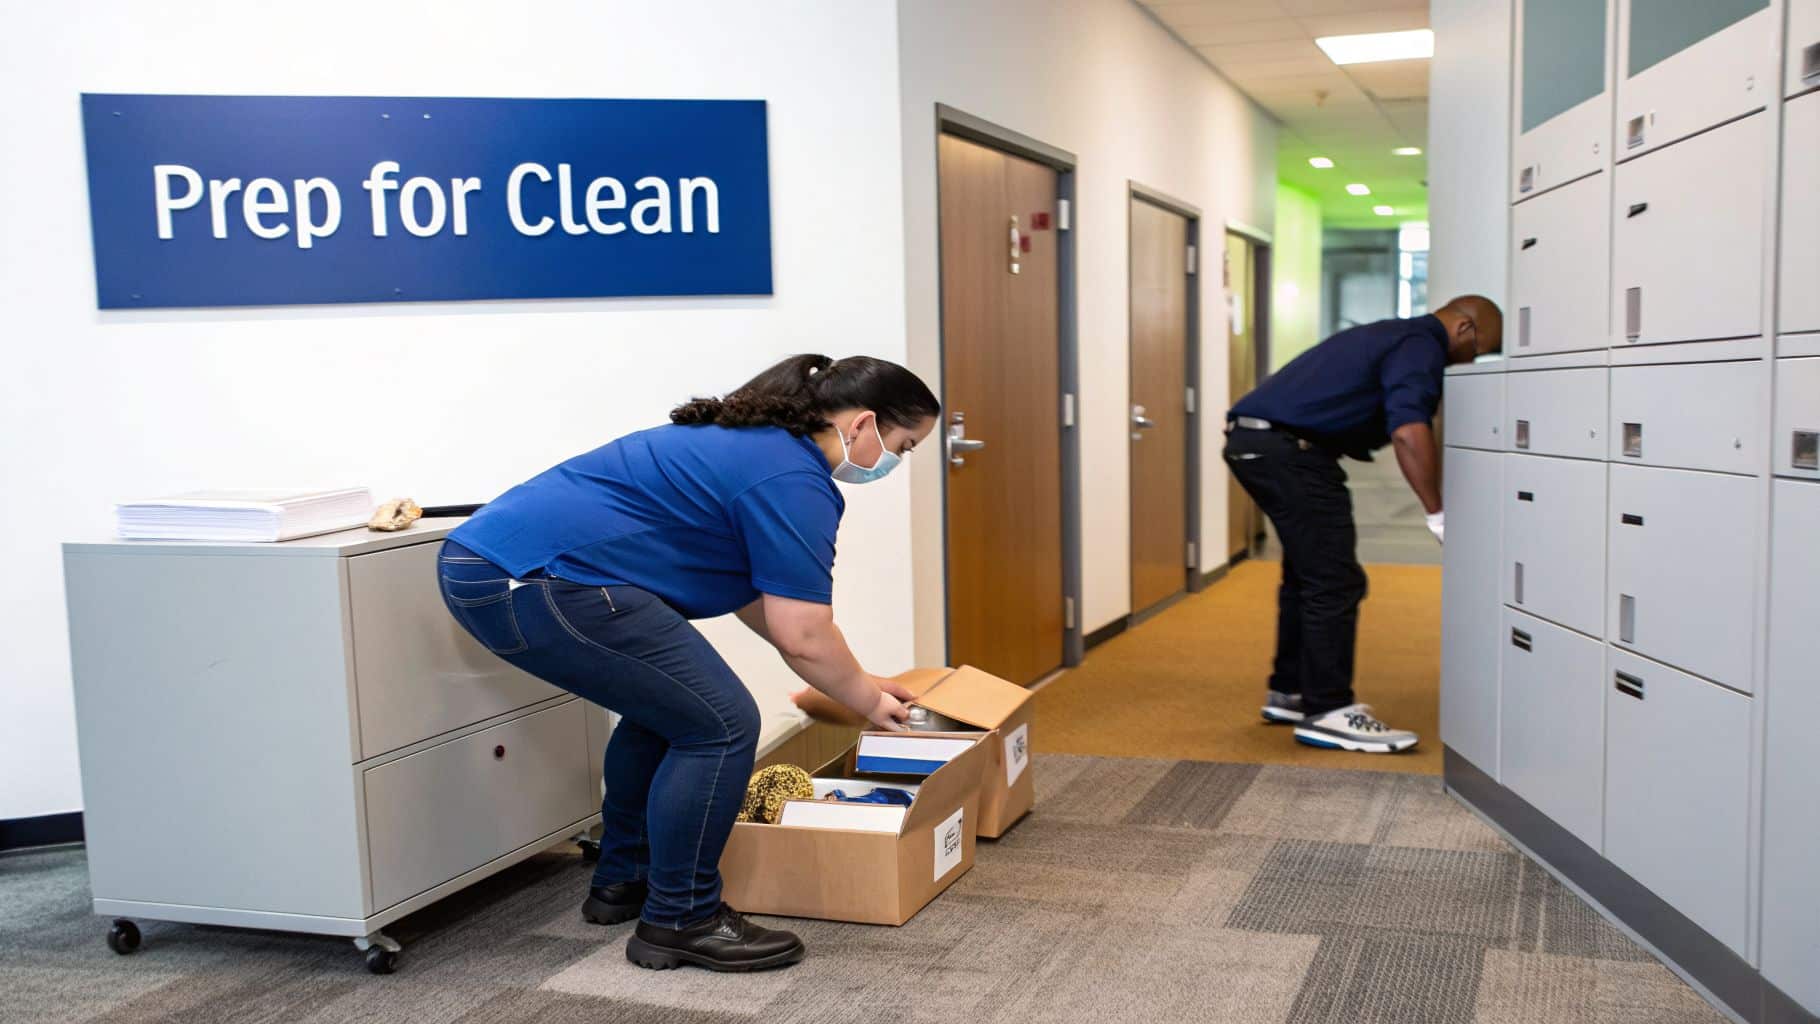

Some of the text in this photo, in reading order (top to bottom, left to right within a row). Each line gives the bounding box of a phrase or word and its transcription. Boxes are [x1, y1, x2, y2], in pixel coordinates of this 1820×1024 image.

[153, 160, 721, 249] Prep for Clean
